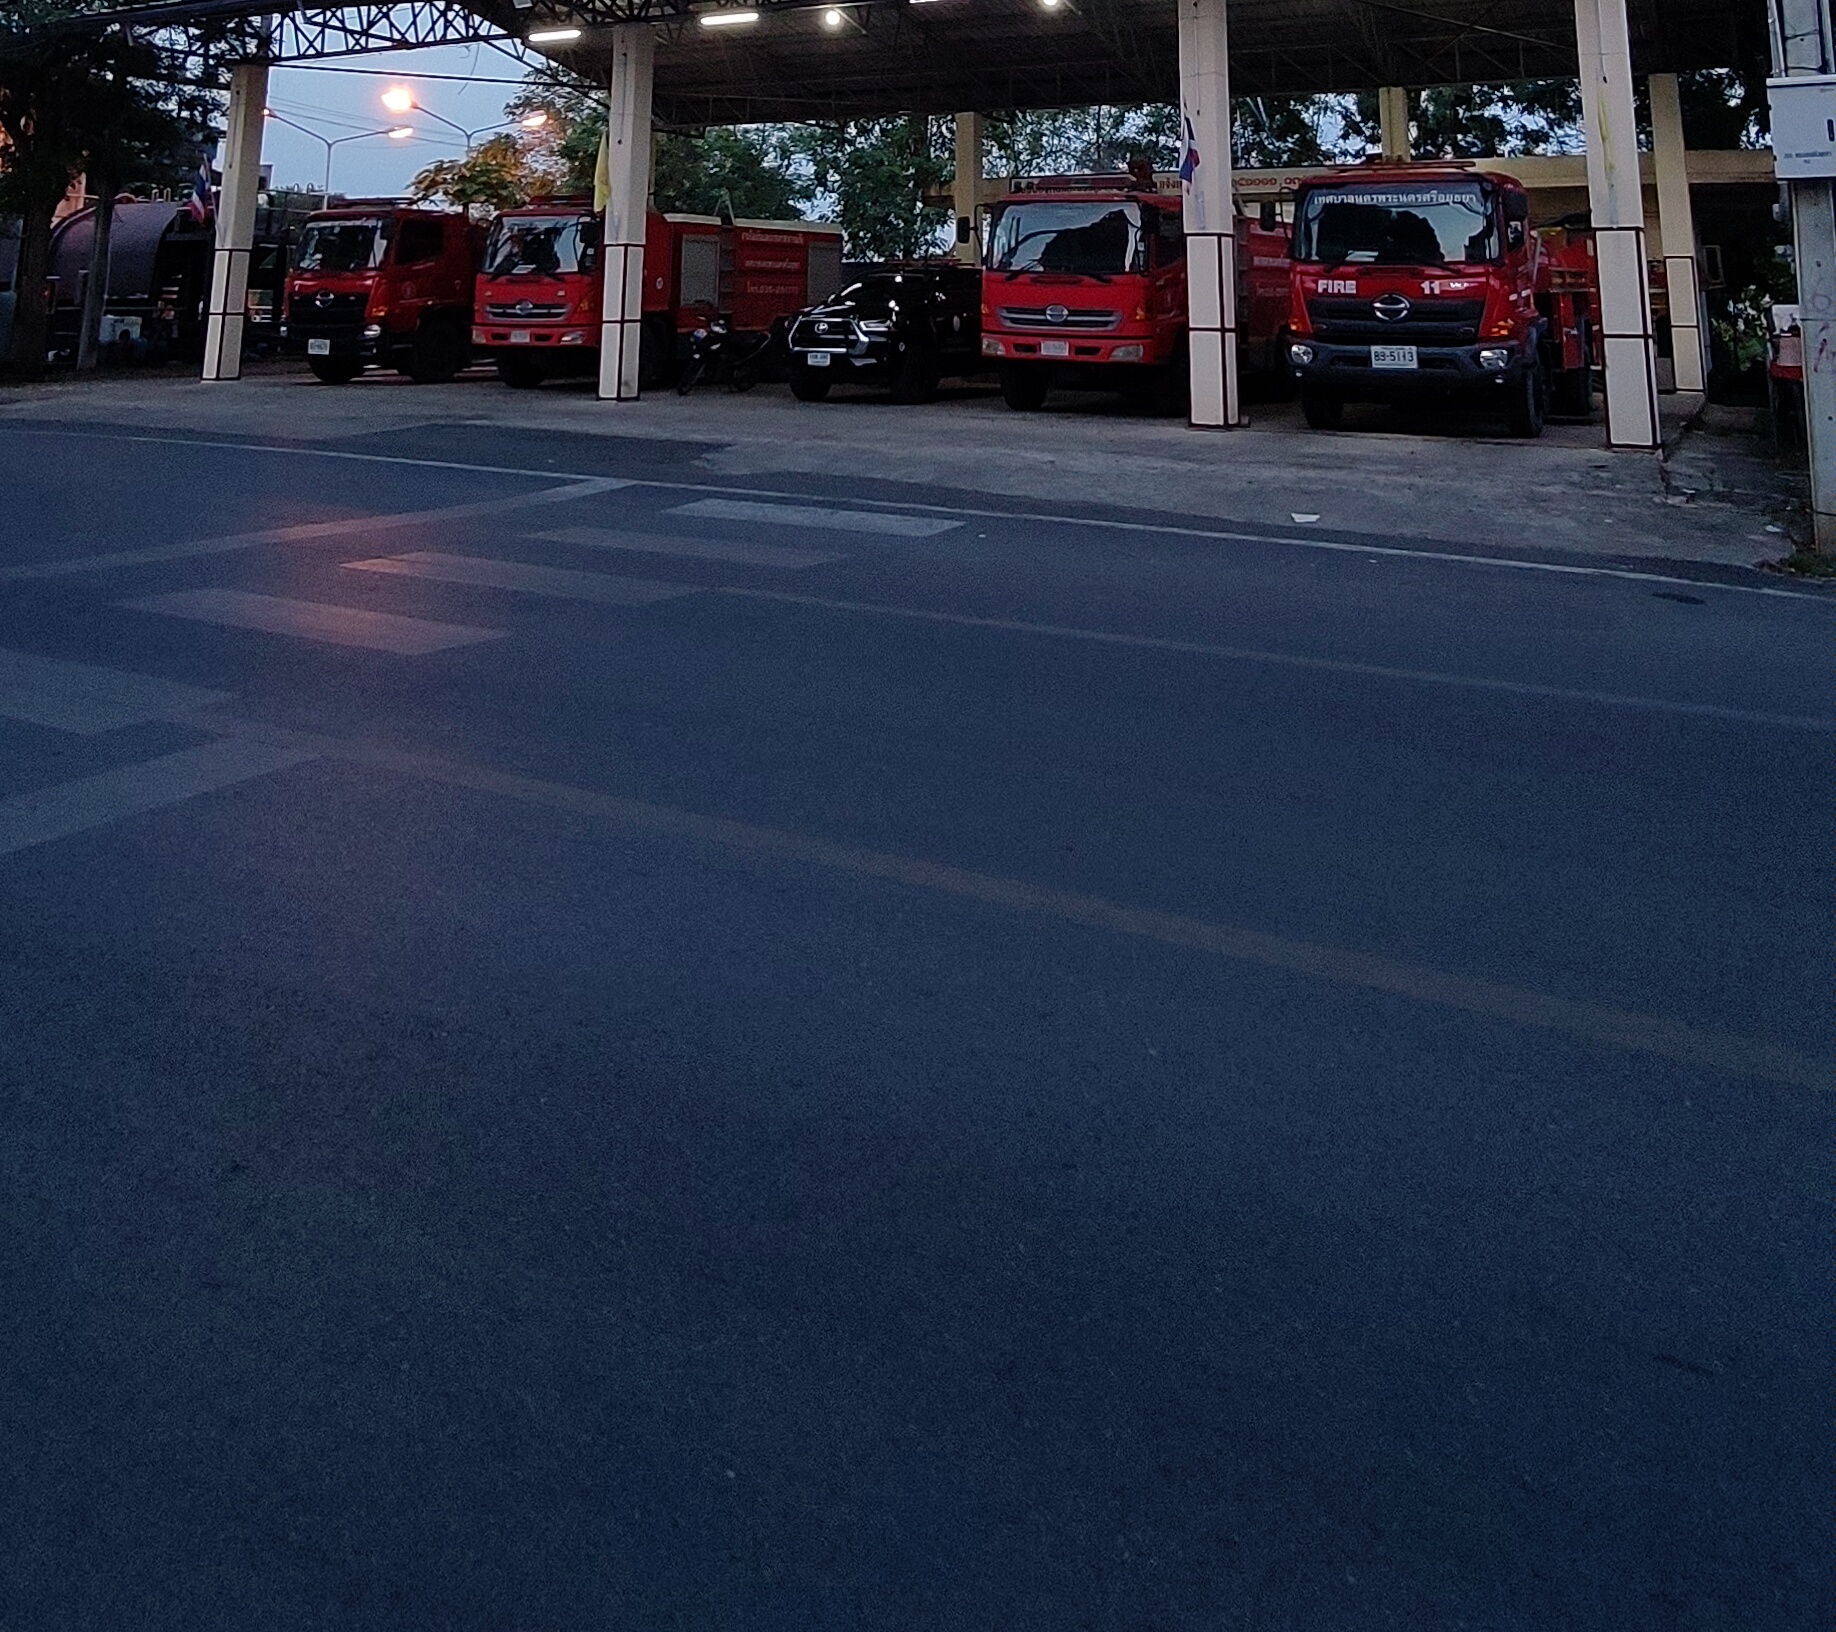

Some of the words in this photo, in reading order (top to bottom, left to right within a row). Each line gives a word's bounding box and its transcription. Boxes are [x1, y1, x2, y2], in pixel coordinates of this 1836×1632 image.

[1314, 190, 1477, 206] เทศบาลนครพระนครศรีอยุธยา
[1317, 279, 1357, 294] FIRE
[1420, 280, 1441, 294] 11
